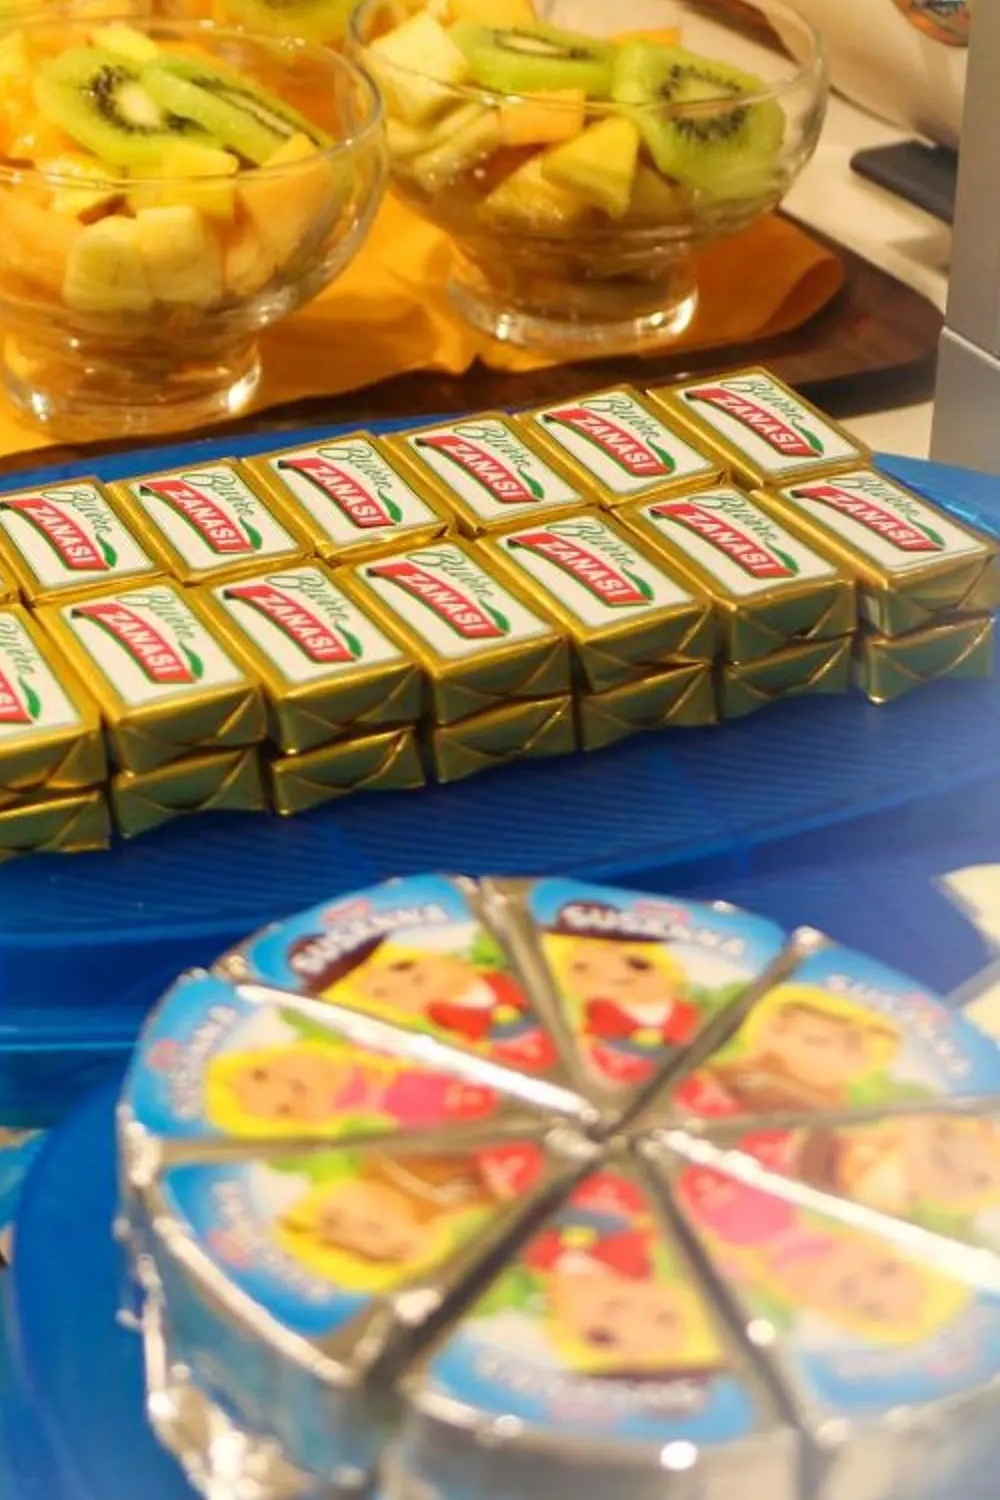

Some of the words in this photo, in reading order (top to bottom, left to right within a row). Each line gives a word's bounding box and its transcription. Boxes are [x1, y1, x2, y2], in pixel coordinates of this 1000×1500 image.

[571, 417, 656, 468] ZANASI
[718, 399, 804, 450] ZANASI
[309, 465, 383, 522] ZANASI
[449, 443, 524, 498] ZANASI
[24, 505, 97, 563] ZANASI
[169, 489, 243, 545] ZANASI
[690, 512, 776, 573] ZANASI
[828, 495, 924, 548] ZANASI
[536, 541, 629, 597] ZANASI
[253, 593, 337, 655] ZANASI
[401, 572, 488, 630] ZANASI
[97, 611, 180, 674] ZANASI
